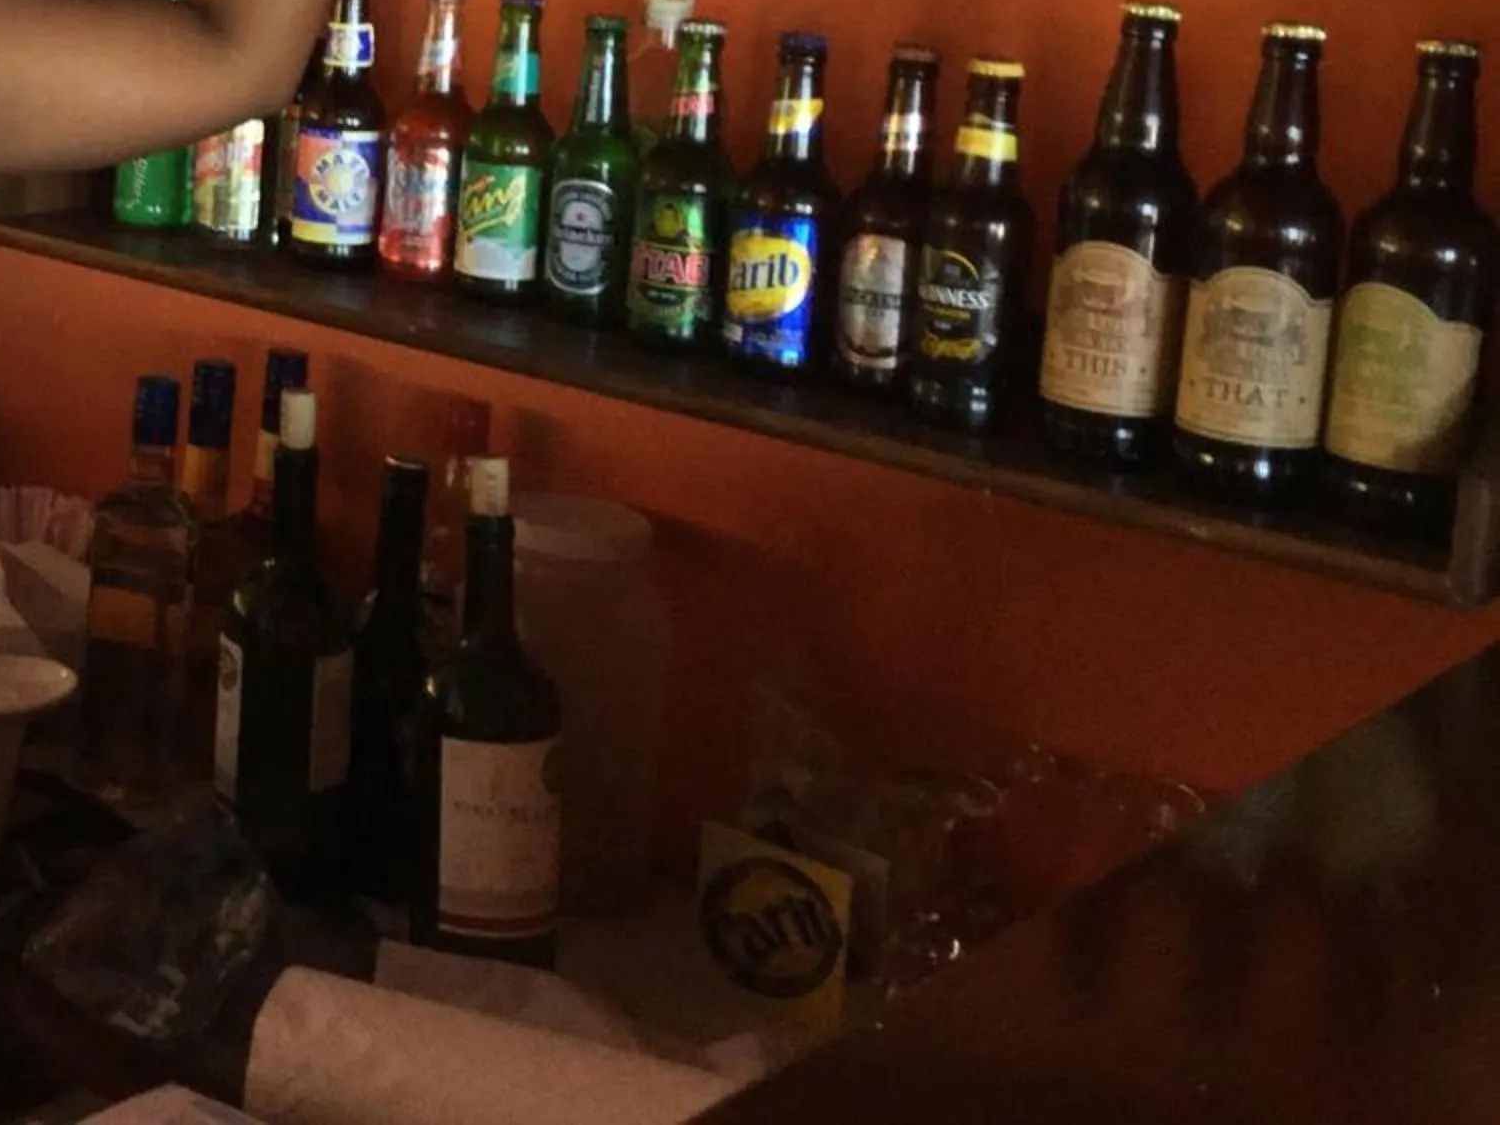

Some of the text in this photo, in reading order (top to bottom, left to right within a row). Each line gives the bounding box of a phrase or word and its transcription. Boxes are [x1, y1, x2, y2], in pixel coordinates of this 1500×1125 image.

[730, 251, 802, 291] arib
[1063, 347, 1127, 378] THIS
[1200, 376, 1289, 409] THAT
